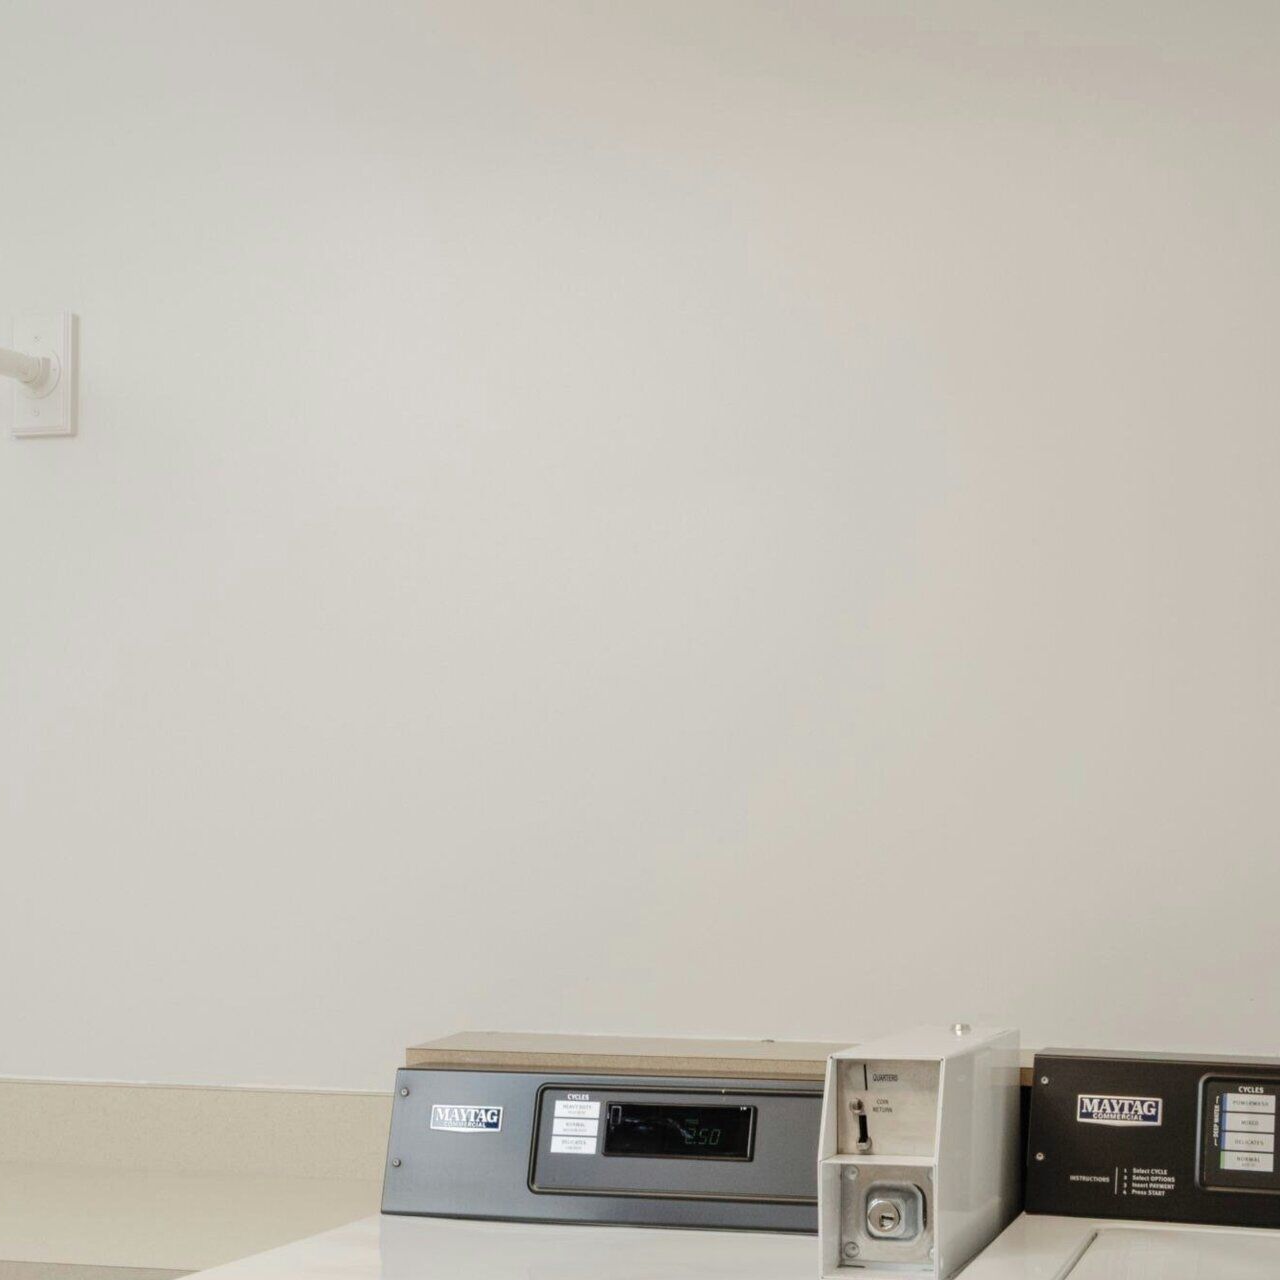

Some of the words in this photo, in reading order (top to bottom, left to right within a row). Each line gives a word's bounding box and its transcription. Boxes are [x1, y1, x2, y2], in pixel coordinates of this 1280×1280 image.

[872, 1073, 899, 1082] QUARTERS
[1238, 1085, 1264, 1094] CYCLES
[567, 1093, 589, 1101] CYCLES
[1081, 1098, 1157, 1116] MAYTAG
[435, 1107, 498, 1123] MAYTAG
[1092, 1112, 1144, 1121] COMMERCIAL
[1069, 1175, 1110, 1183] INSTRUCTIONS
